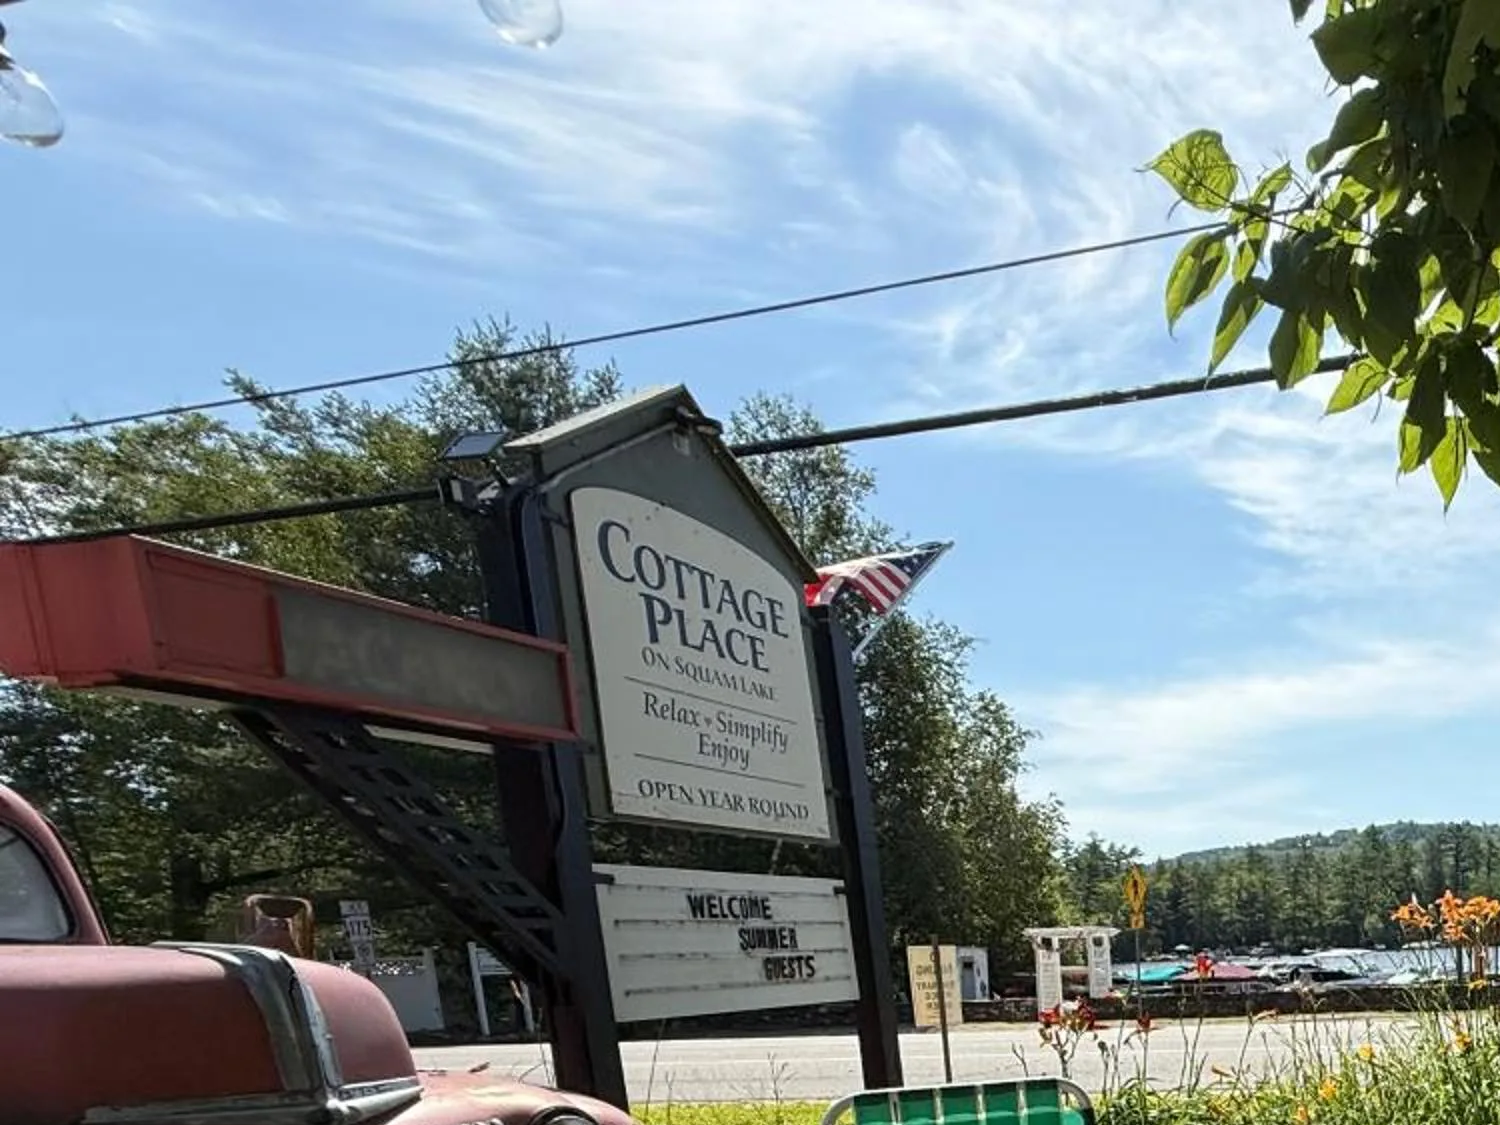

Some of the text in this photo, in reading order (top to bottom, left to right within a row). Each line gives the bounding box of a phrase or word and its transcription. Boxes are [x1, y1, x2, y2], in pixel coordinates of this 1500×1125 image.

[597, 520, 789, 639] COTTAGE
[639, 592, 770, 673] PLACE
[641, 647, 778, 701] ON SQUAM LAKE
[643, 692, 788, 753] Relax Simplify
[698, 733, 749, 770] Enjoy
[638, 779, 809, 821] OPEN YEAR ROUND
[687, 894, 772, 919] WELCOME
[738, 927, 798, 951] SUMMER
[764, 955, 815, 981] GUESTS
